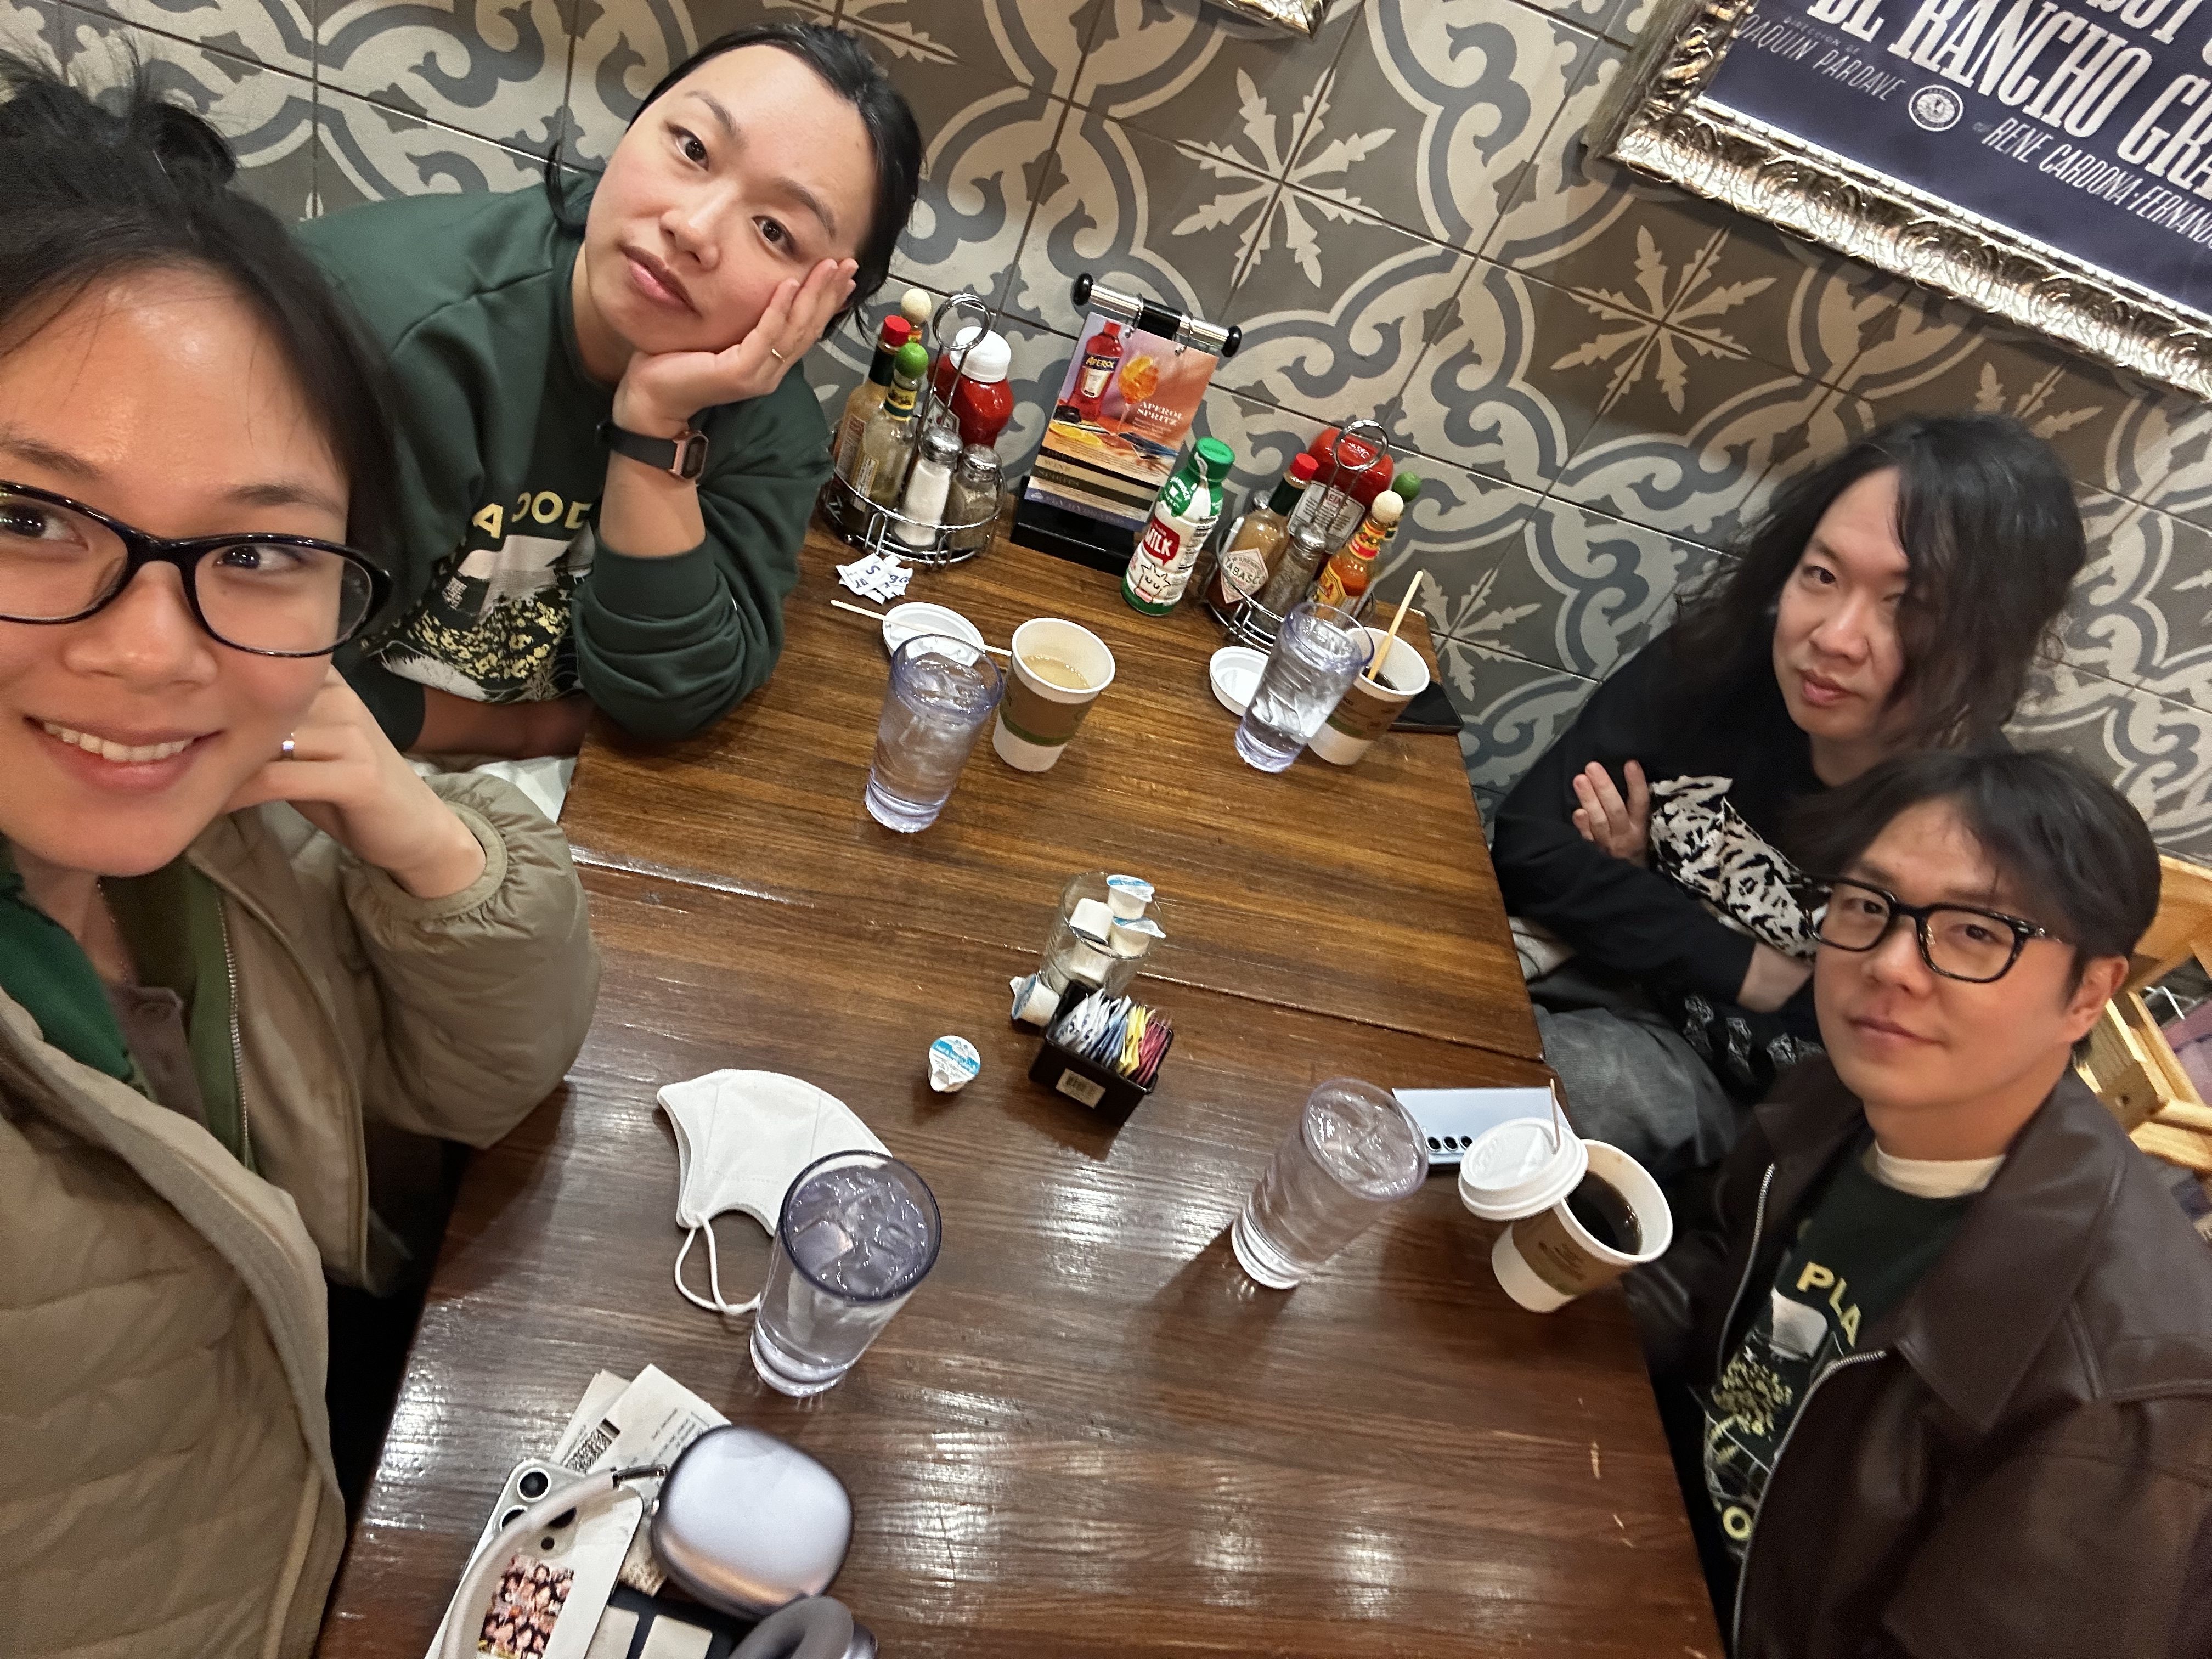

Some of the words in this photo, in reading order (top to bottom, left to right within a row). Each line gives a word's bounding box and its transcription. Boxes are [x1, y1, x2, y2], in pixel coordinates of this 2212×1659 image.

[1736, 14, 1820, 61] OAQUIN
[1812, 49, 1907, 101] PARDAVE
[1888, 0, 2152, 137] RANCHO
[1981, 117, 2054, 163] RENE
[2126, 185, 2212, 250] FERNAND
[1085, 355, 1115, 369] APEROL
[1137, 408, 1178, 426] SPRITZ
[1139, 402, 1183, 420] APEROL
[1144, 528, 1173, 557] MILK
[1224, 556, 1265, 585] TABASCO
